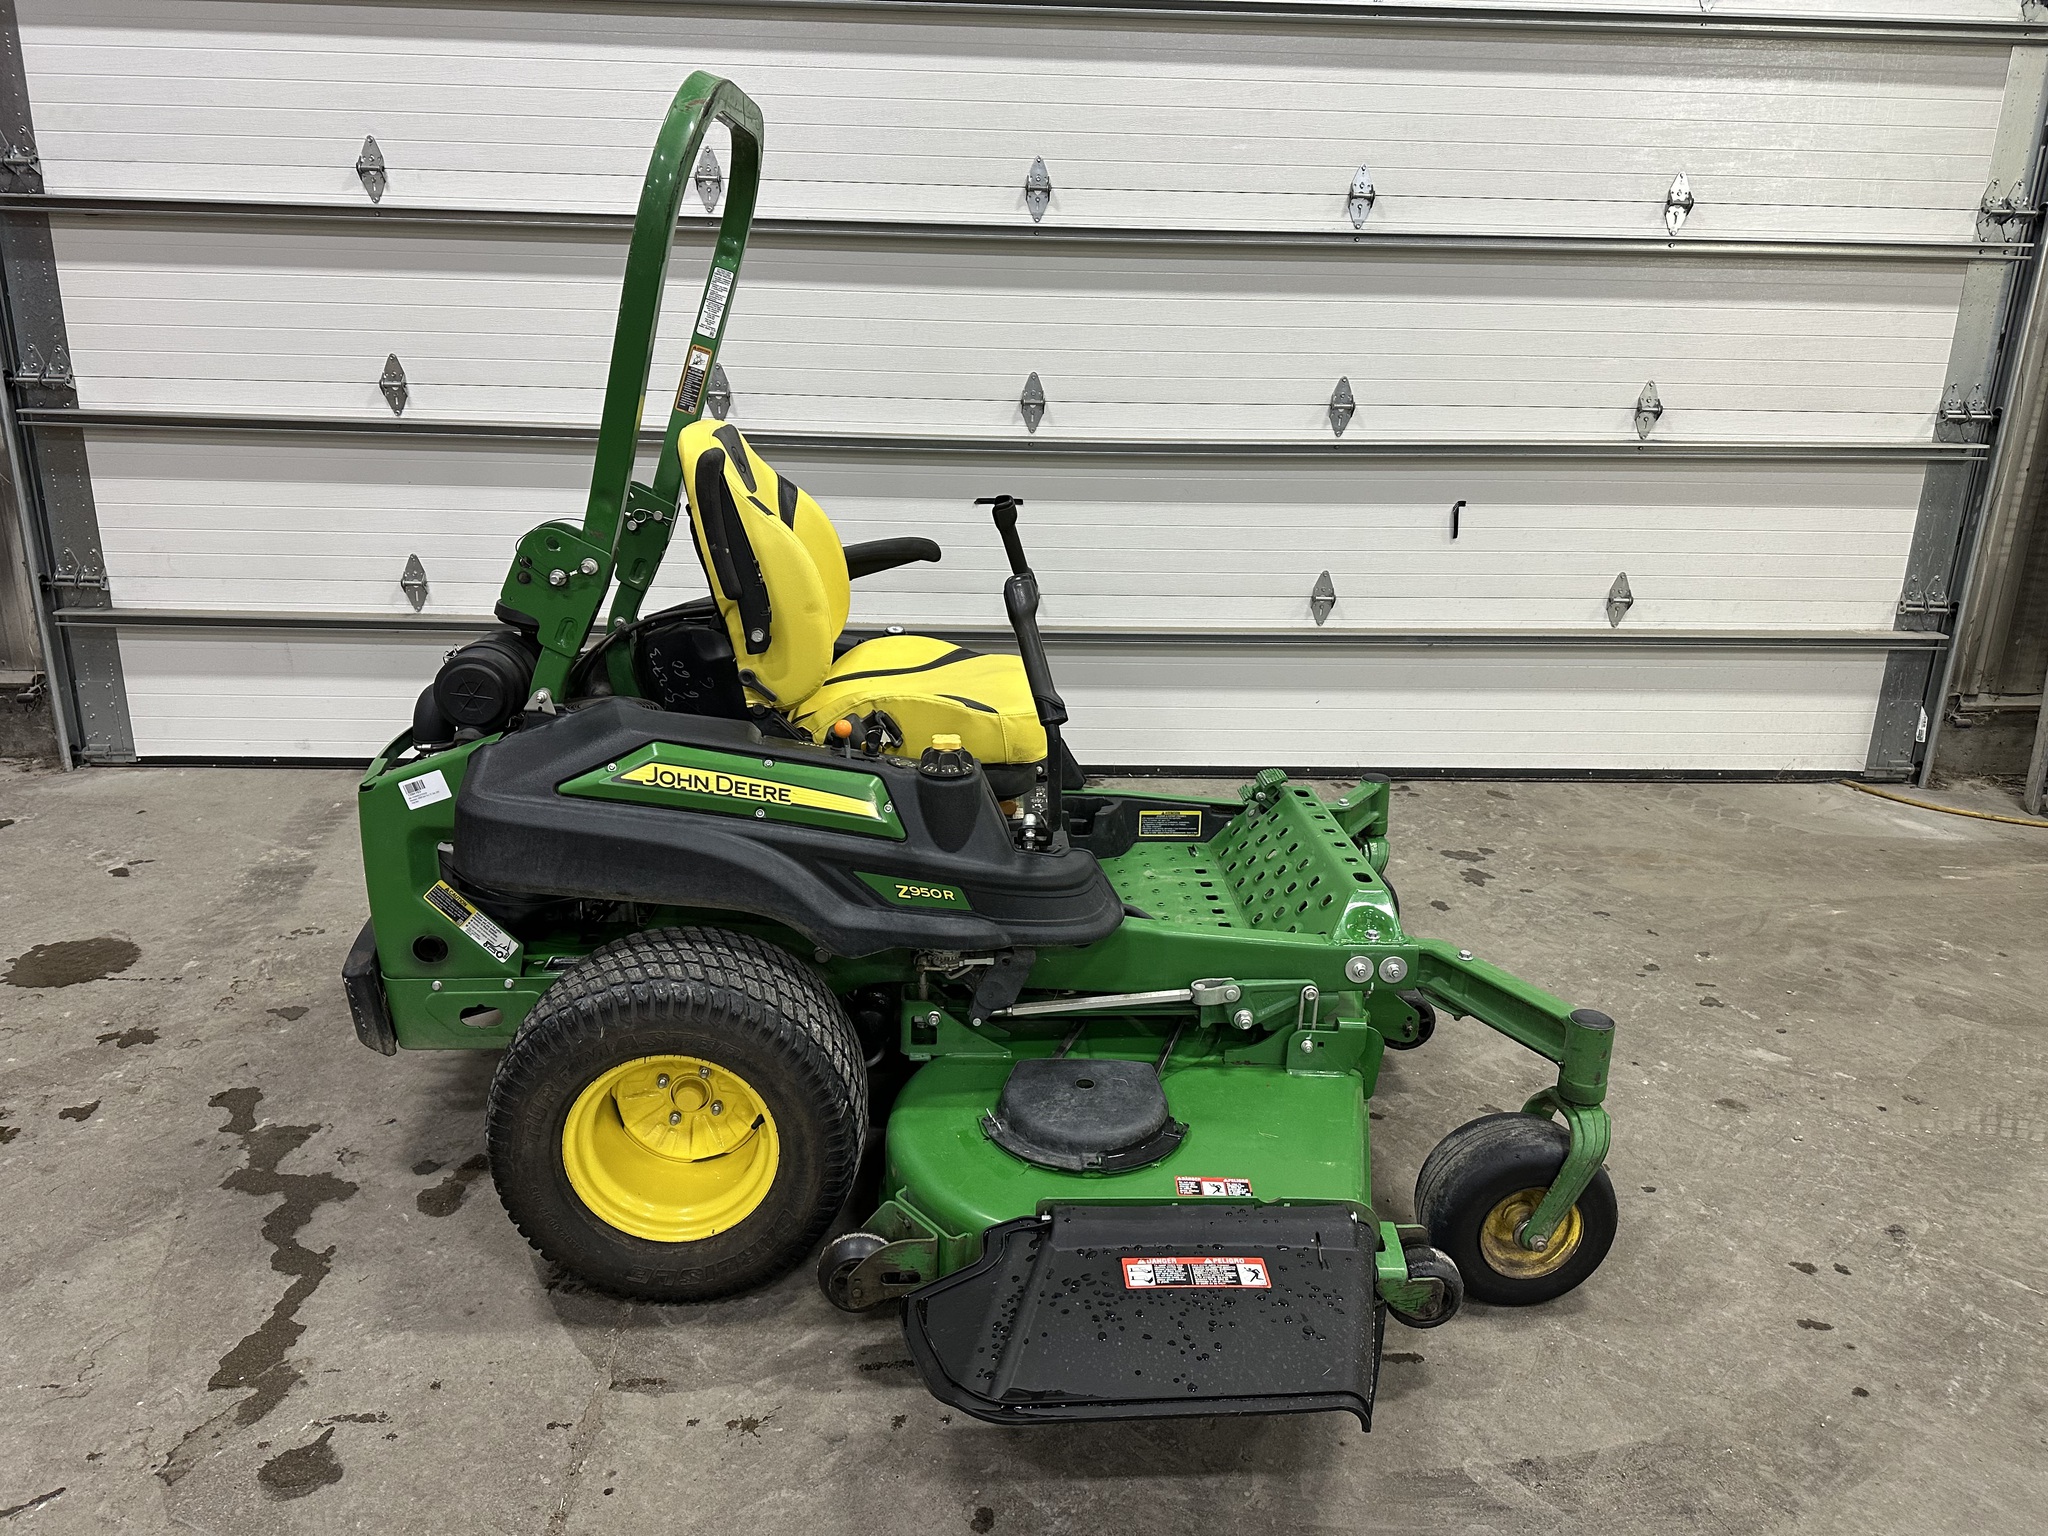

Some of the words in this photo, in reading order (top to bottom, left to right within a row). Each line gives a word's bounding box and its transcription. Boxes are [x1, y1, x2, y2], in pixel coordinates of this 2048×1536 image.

[645, 766, 709, 791] JOHN
[715, 774, 792, 803] DEERE
[449, 888, 468, 907] CAUTION
[895, 884, 956, 901] Z950R
[523, 1065, 570, 1146] TURF
[576, 1030, 743, 1071] MASTER
[626, 1208, 794, 1286] CARLISLE
